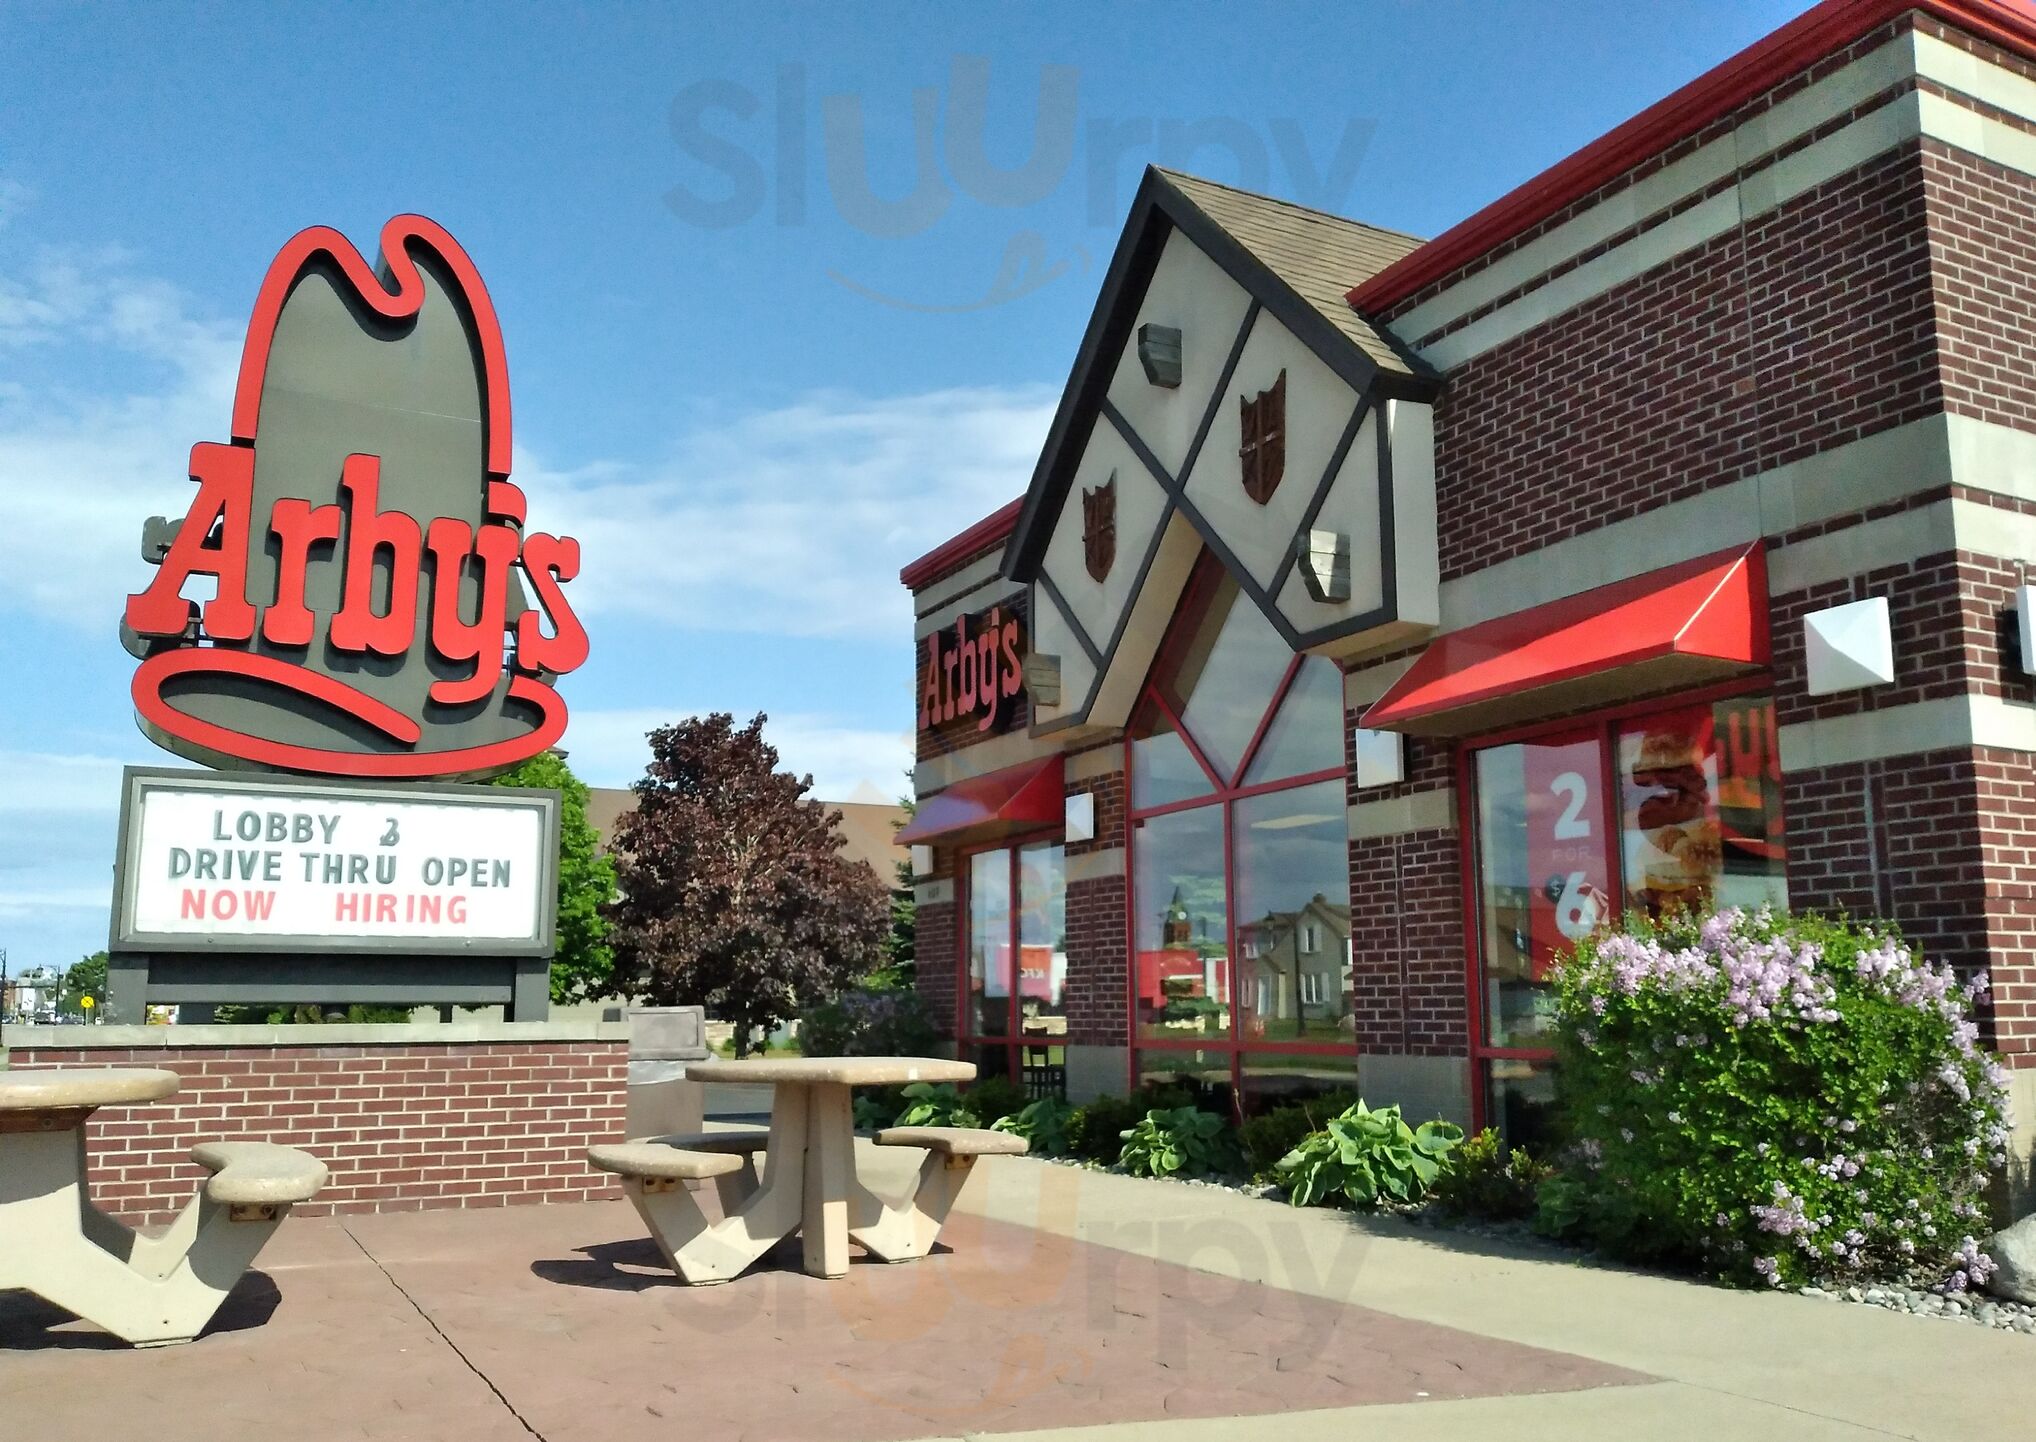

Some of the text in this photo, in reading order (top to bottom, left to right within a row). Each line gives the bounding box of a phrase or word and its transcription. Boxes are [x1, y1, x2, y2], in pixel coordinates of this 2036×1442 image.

[126, 441, 590, 704] Arby's
[919, 607, 1022, 732] Arby's
[213, 809, 341, 844] LOBBY
[1550, 771, 1591, 841] 2
[168, 847, 511, 888] DRIVE THRU OPEN
[1552, 846, 1591, 861] FOR
[181, 888, 467, 924] NOW HIRING
